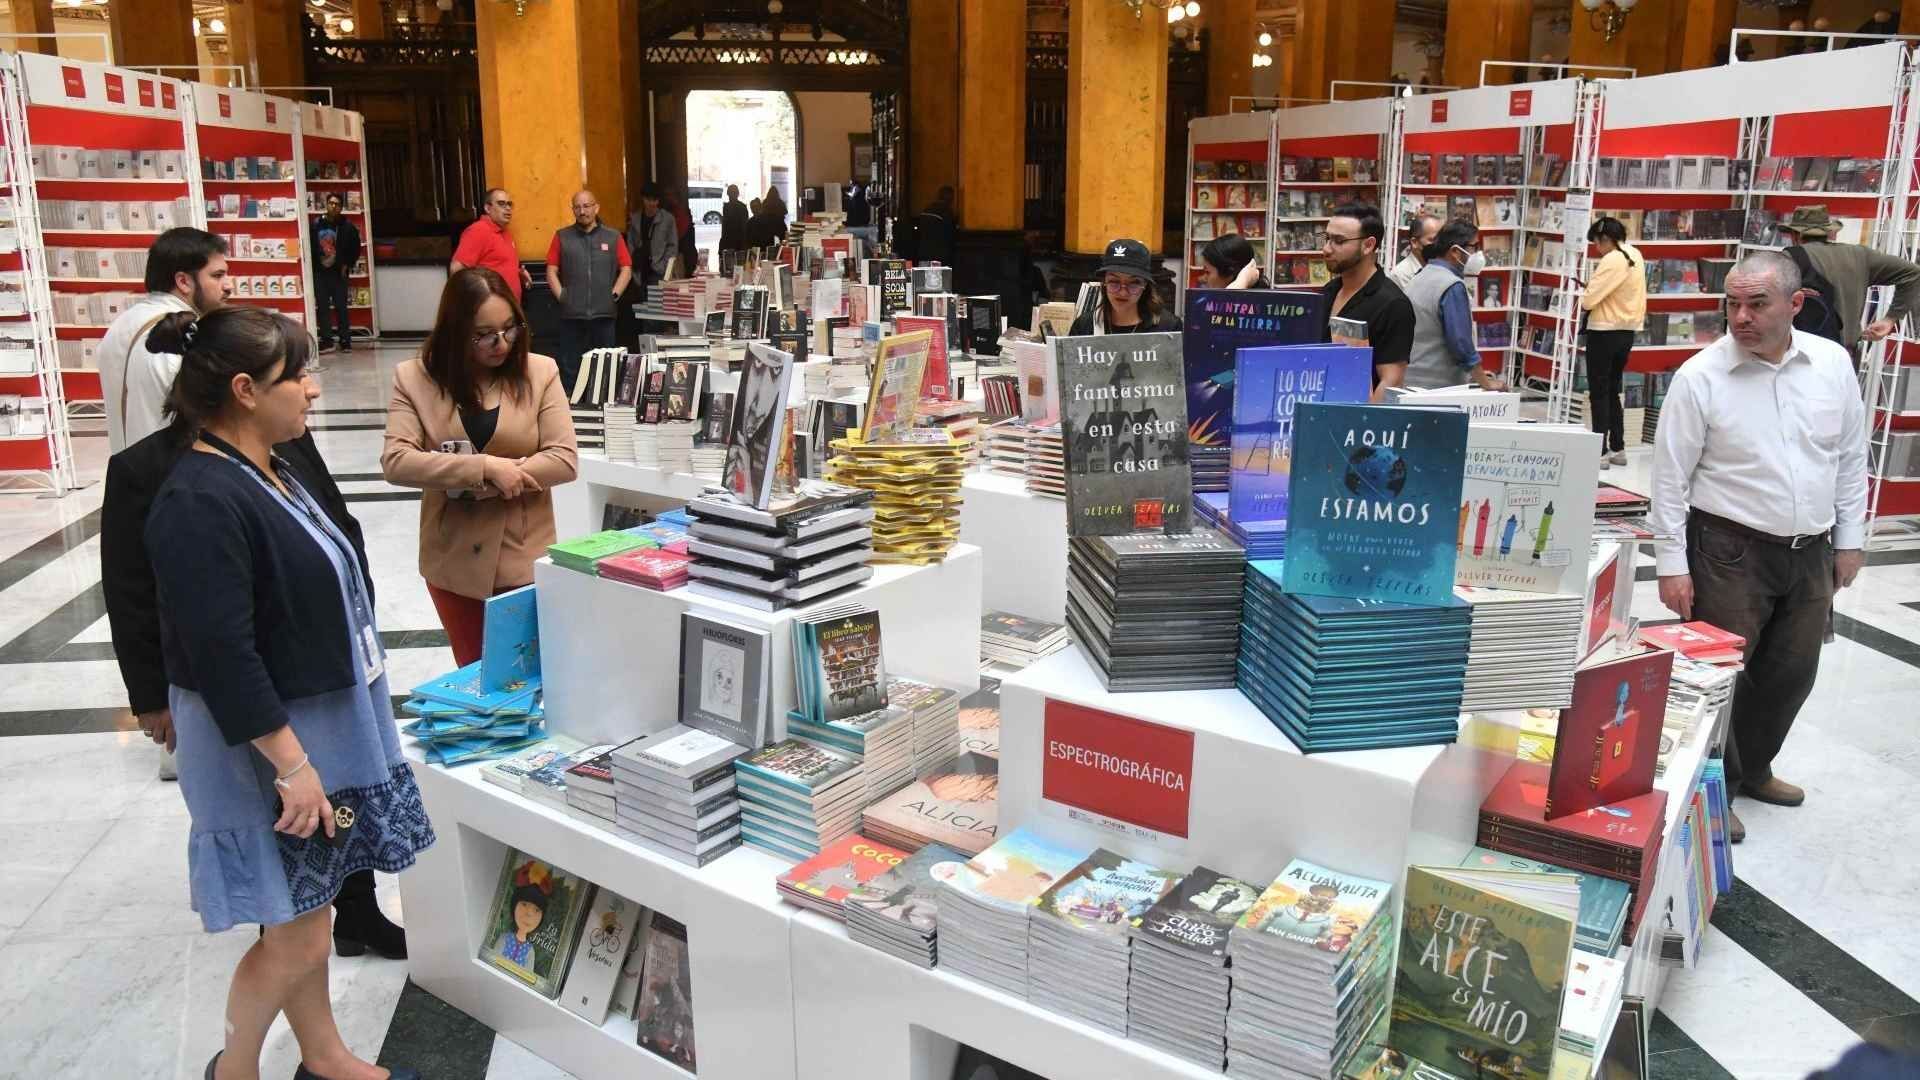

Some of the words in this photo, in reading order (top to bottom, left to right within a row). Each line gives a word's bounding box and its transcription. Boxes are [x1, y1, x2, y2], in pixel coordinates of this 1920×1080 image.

[885, 270, 905, 280] BELA
[1205, 301, 1259, 315] MIENTRAS
[1266, 304, 1304, 316] TANTO
[1211, 315, 1222, 324] EN
[1225, 316, 1234, 326] LA
[1238, 317, 1280, 330] TIERRA
[1077, 346, 1117, 366] Hay
[1133, 347, 1159, 362] un
[1279, 370, 1294, 391] LO
[1300, 369, 1325, 391] QUE
[1074, 383, 1175, 401] fantasma
[1089, 423, 1114, 437] en
[1132, 419, 1175, 435] esta
[1344, 424, 1412, 449] AQUÍ
[1113, 459, 1159, 473] casa
[1511, 454, 1560, 467] CRAYONES
[1084, 504, 1124, 517] OLIVER
[1320, 497, 1431, 525] ESTAMOS
[1049, 740, 1185, 791] ESPECTROGRÁFICA
[903, 801, 999, 837] ALICIA
[1157, 923, 1216, 945] perdido
[1167, 913, 1215, 937] chico
[1434, 905, 1487, 943] ESTE
[1420, 932, 1509, 995] ALCE
[1452, 986, 1471, 1005] ES
[1466, 996, 1528, 1045] MÍO
